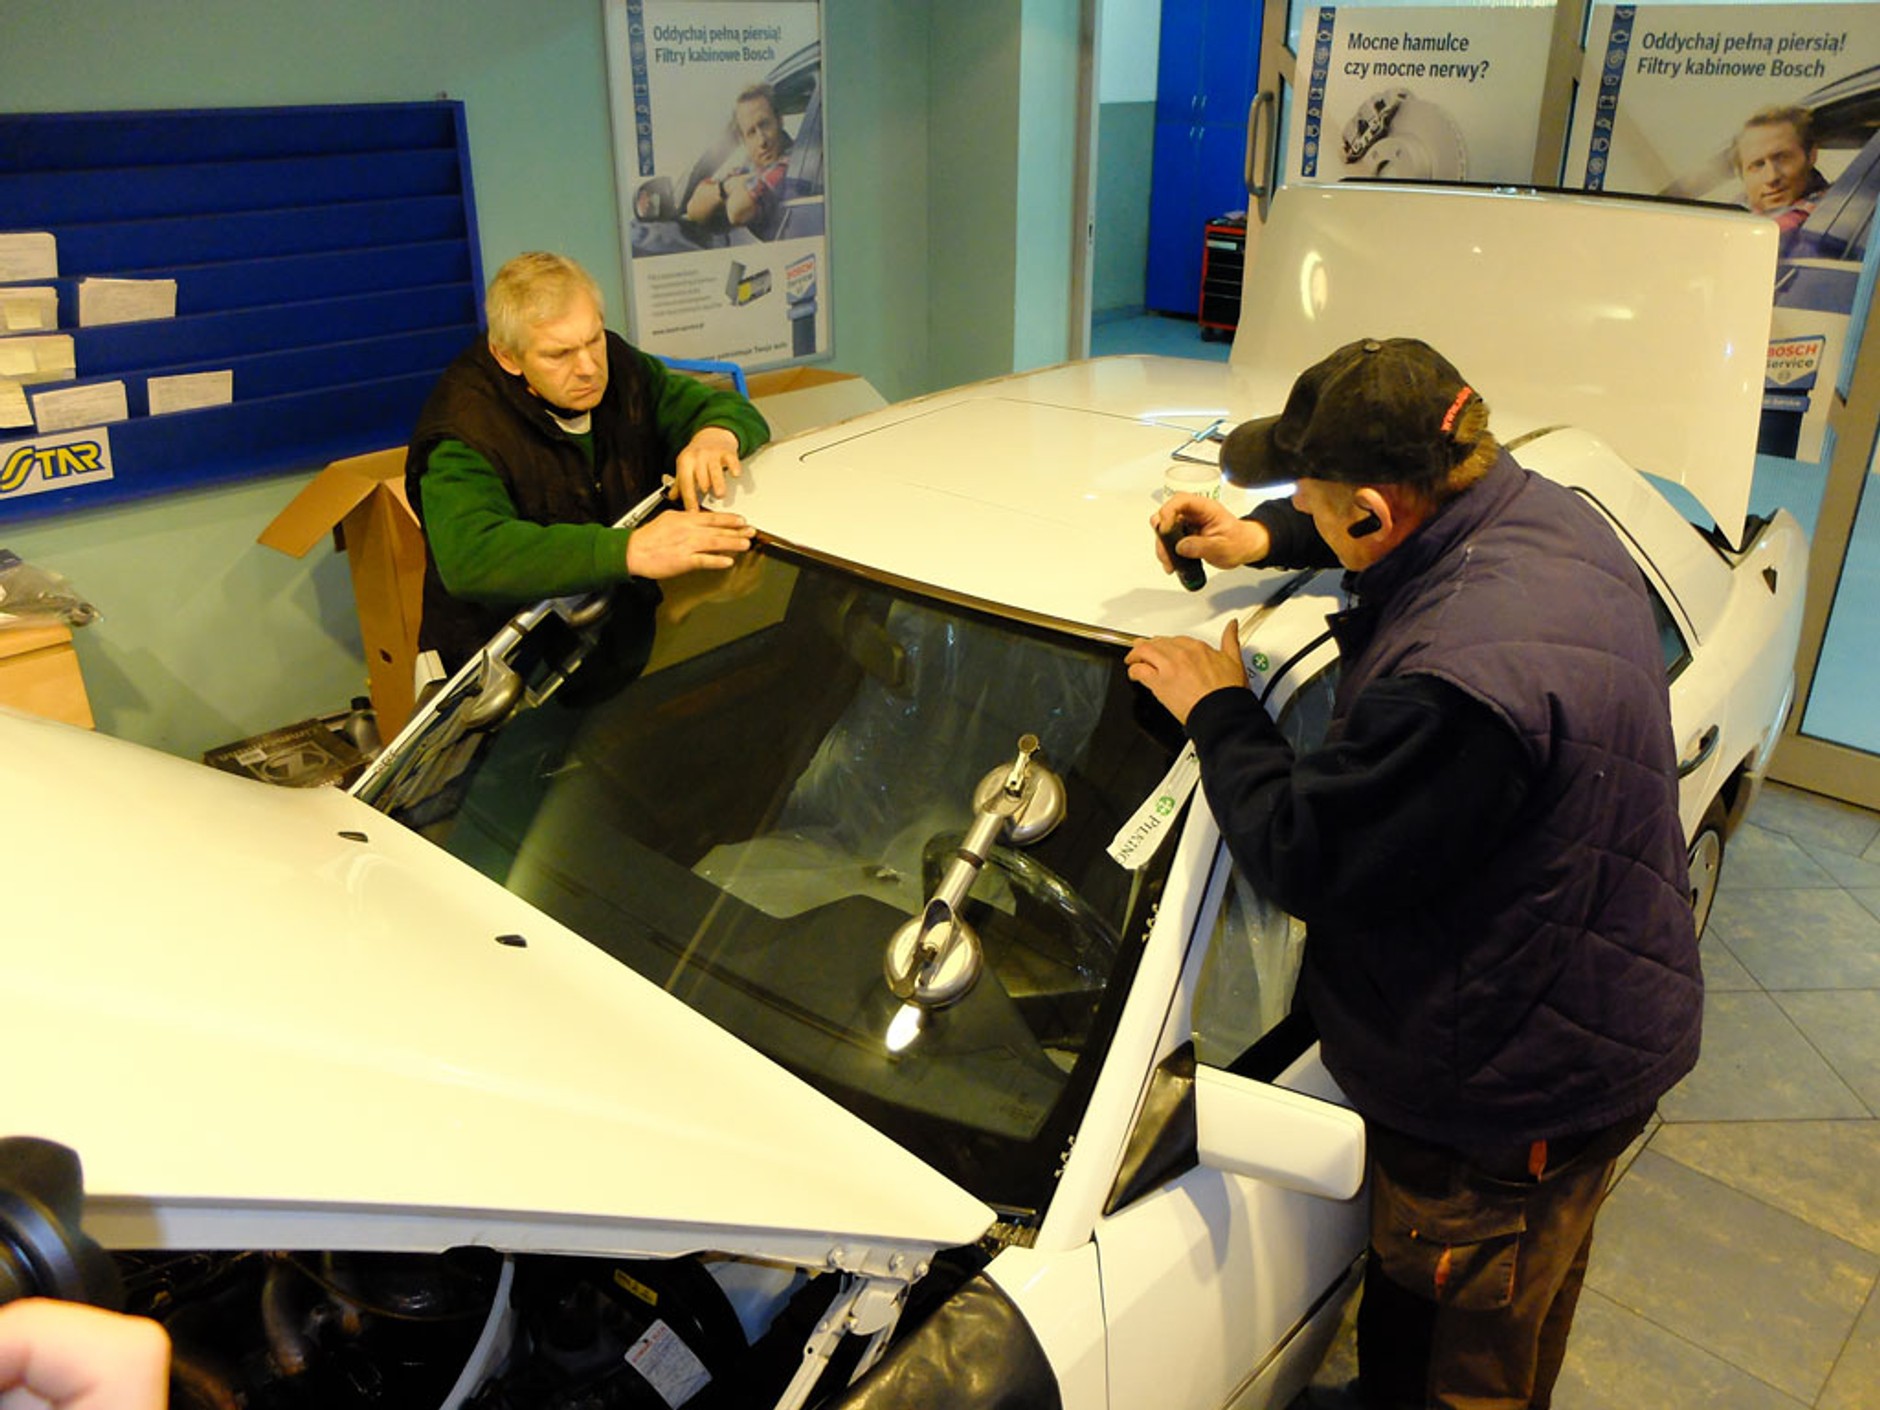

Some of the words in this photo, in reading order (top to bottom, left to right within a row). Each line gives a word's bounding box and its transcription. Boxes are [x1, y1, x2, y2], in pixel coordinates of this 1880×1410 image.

[653, 25, 707, 44] Oddychaj
[709, 25, 741, 43] pełną
[1347, 32, 1399, 51] Mocne
[1402, 32, 1470, 51] hamulce
[1642, 32, 1720, 53] Oddychaj
[1723, 33, 1773, 54] pełną
[1777, 33, 1847, 56] piersią!
[655, 48, 686, 65] Filtry
[688, 46, 741, 62] kabinowe
[742, 46, 775, 62] Bosch
[1344, 61, 1370, 80] czy
[1373, 62, 1426, 76] mocne
[1429, 60, 1490, 82] nerwy?
[1637, 57, 1681, 78] Filtry
[1685, 58, 1766, 77] kabinowe
[1770, 59, 1825, 77] Bosch
[1767, 344, 1818, 358] BOSCH
[0, 441, 105, 492] STAR
